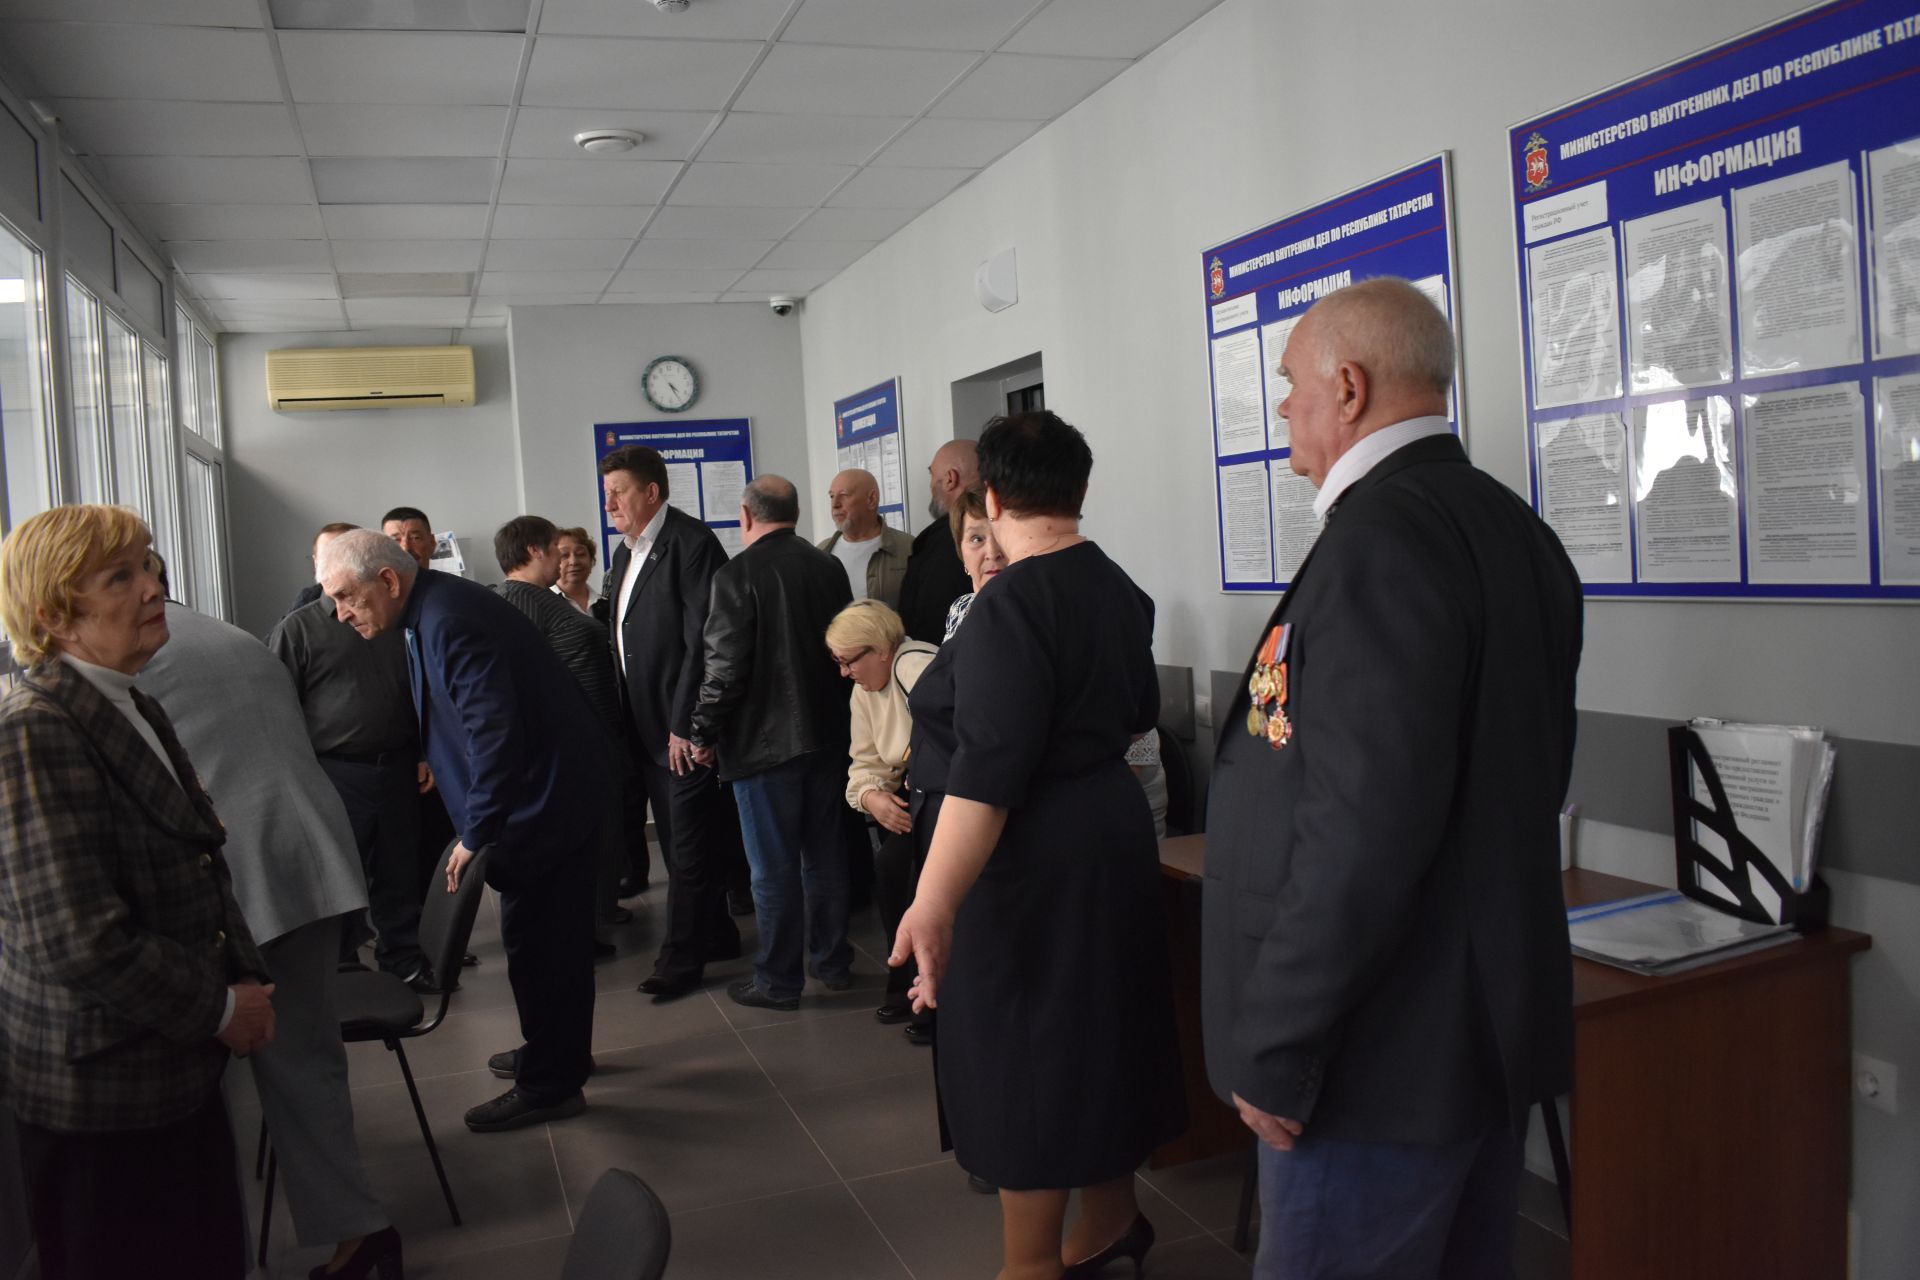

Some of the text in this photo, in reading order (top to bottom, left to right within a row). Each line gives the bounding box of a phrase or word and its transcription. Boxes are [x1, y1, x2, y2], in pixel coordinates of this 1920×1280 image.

[1560, 114, 1648, 160] МИНИСТЕРСТВО
[1650, 85, 1730, 128] ВНУТРЕННИХ
[1732, 73, 1760, 102] ДЕЛ
[1762, 65, 1782, 89] ПО
[1784, 29, 1882, 80] РЕСПУБЛИКЕ
[1654, 125, 1801, 196] ИНФОРМАЦИЯ
[1229, 192, 1433, 278] МИНИСТЕРСТВО ВНУТРЕННИХ ДЕЛ ПО РЕСПУБЛИКЕ ТАТАРСТАН
[1278, 270, 1351, 310] ИНФОРМАЦИЯ
